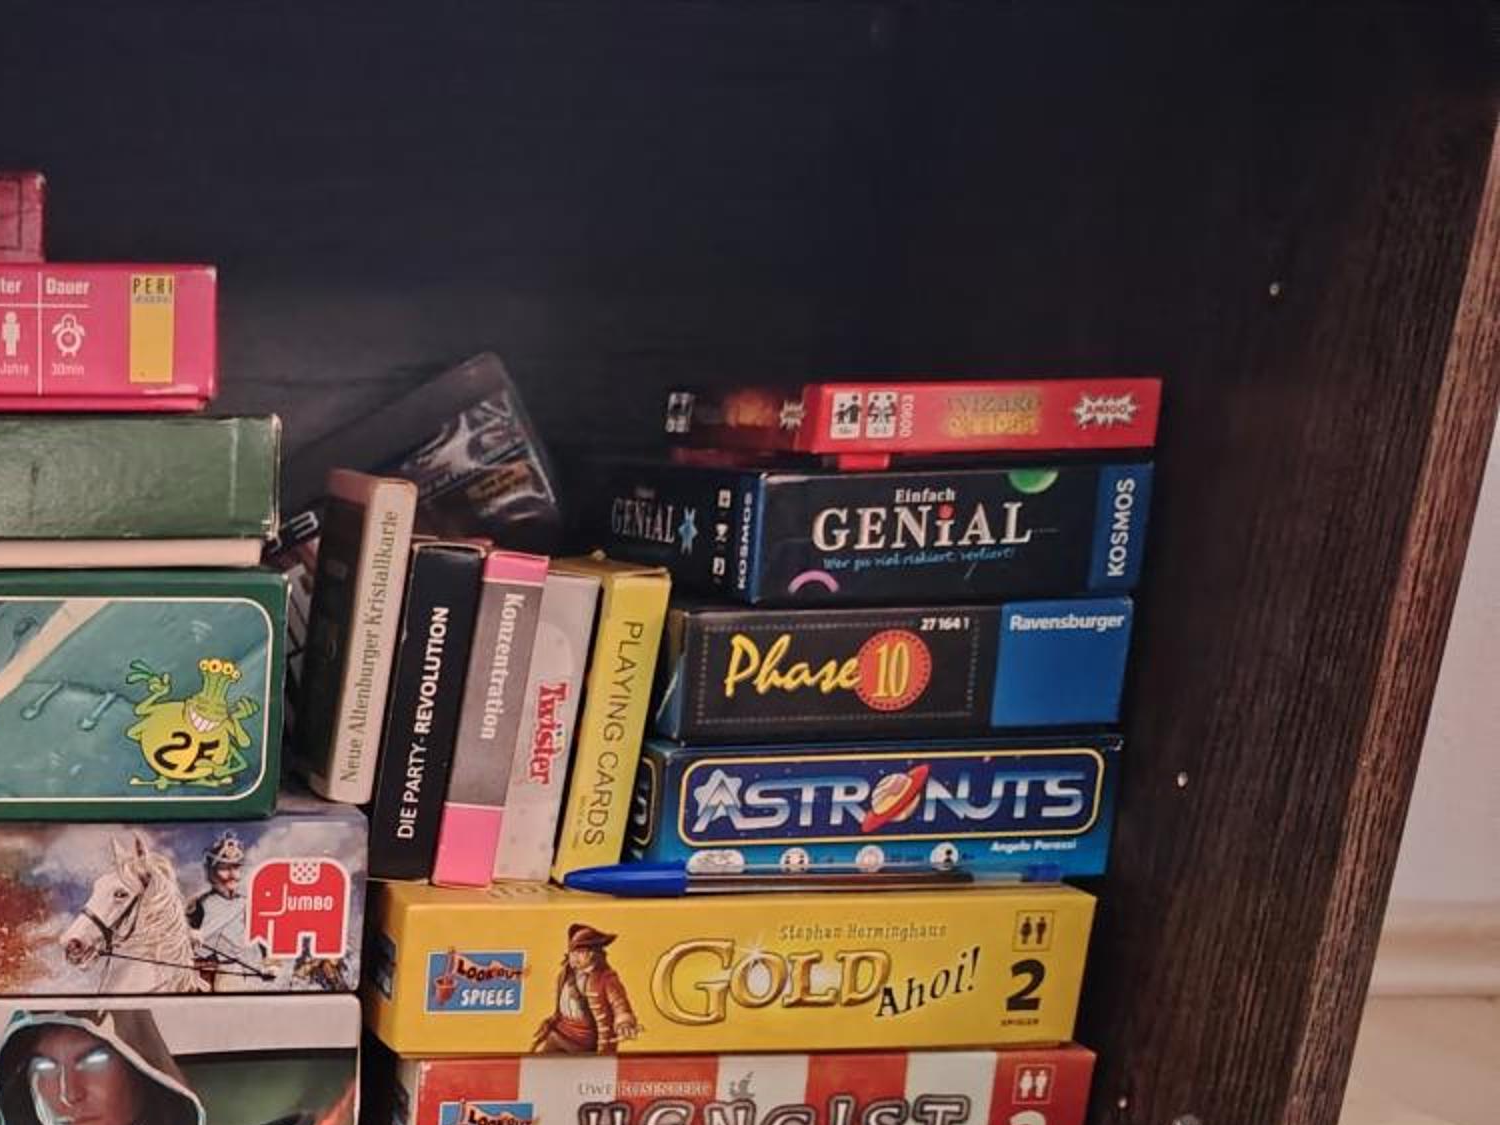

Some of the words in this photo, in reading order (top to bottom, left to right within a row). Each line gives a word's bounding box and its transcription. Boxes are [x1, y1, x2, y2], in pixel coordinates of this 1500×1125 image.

[46, 278, 89, 295] Dauer
[133, 277, 173, 295] PERI
[895, 488, 956, 503] Einfach
[1106, 477, 1137, 578] KOSMOS
[370, 510, 400, 626] Kristallkarte
[1008, 612, 1126, 633] Ravensburger
[348, 628, 380, 733] Altenburger
[414, 606, 449, 735] REVOLUTION
[480, 592, 525, 740] Konzentration
[603, 620, 645, 742] PLAYING
[723, 633, 862, 698] Phase
[873, 641, 911, 699] 10
[340, 737, 362, 784] Neue
[404, 742, 427, 802] PARTY
[528, 681, 571, 786] Twister
[397, 806, 414, 839] DIE
[583, 751, 620, 846] CARDS
[650, 938, 891, 1026] GOLD
[875, 945, 981, 1019] Ahoi!
[1005, 958, 1046, 1012] 2
